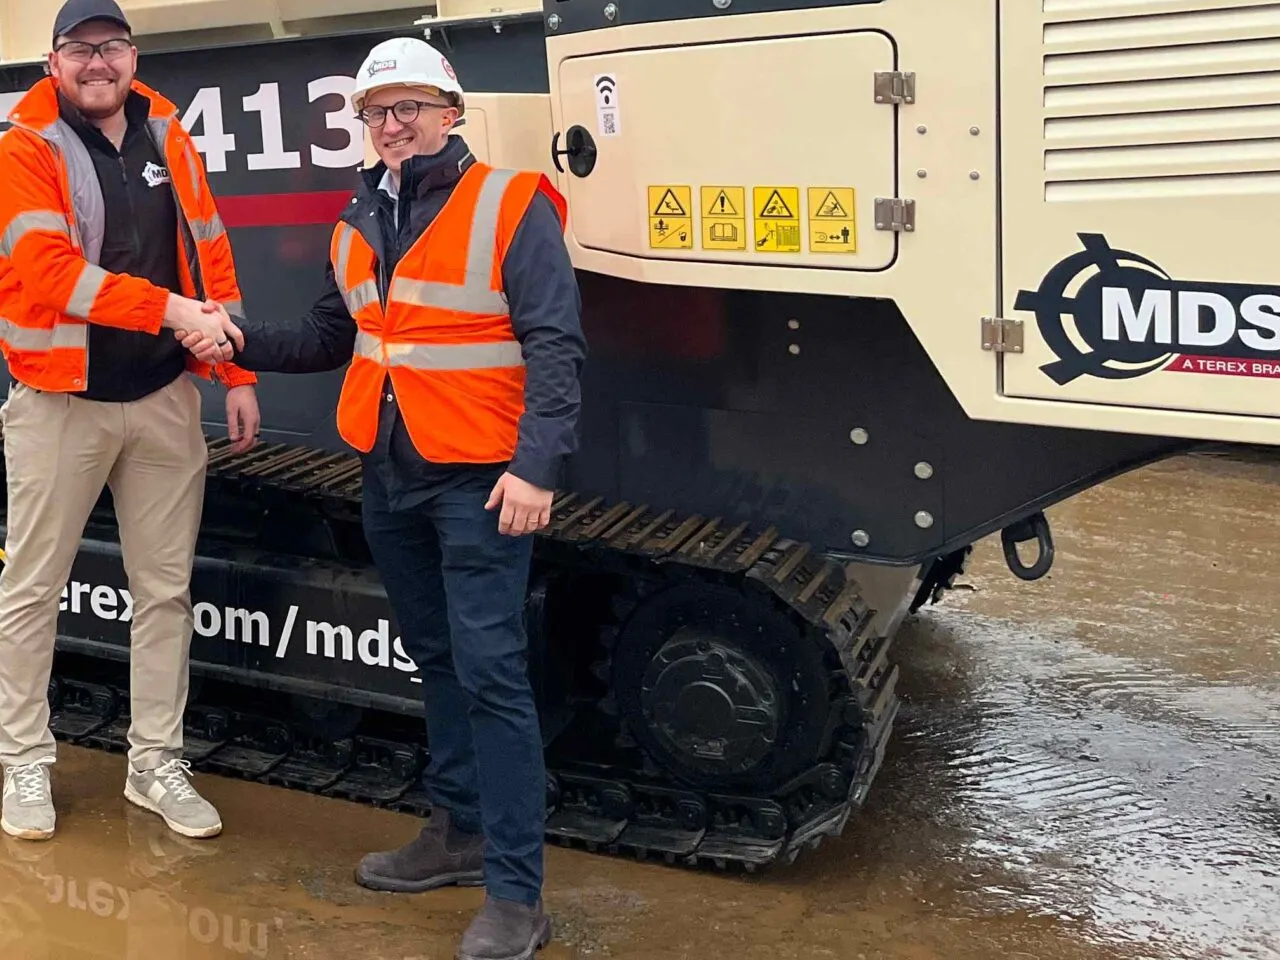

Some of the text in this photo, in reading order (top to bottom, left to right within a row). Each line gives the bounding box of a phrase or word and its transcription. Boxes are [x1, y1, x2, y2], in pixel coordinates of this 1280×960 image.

[1102, 286, 1280, 351] MDS
[1182, 359, 1193, 370] A
[1197, 360, 1248, 373] TEREX
